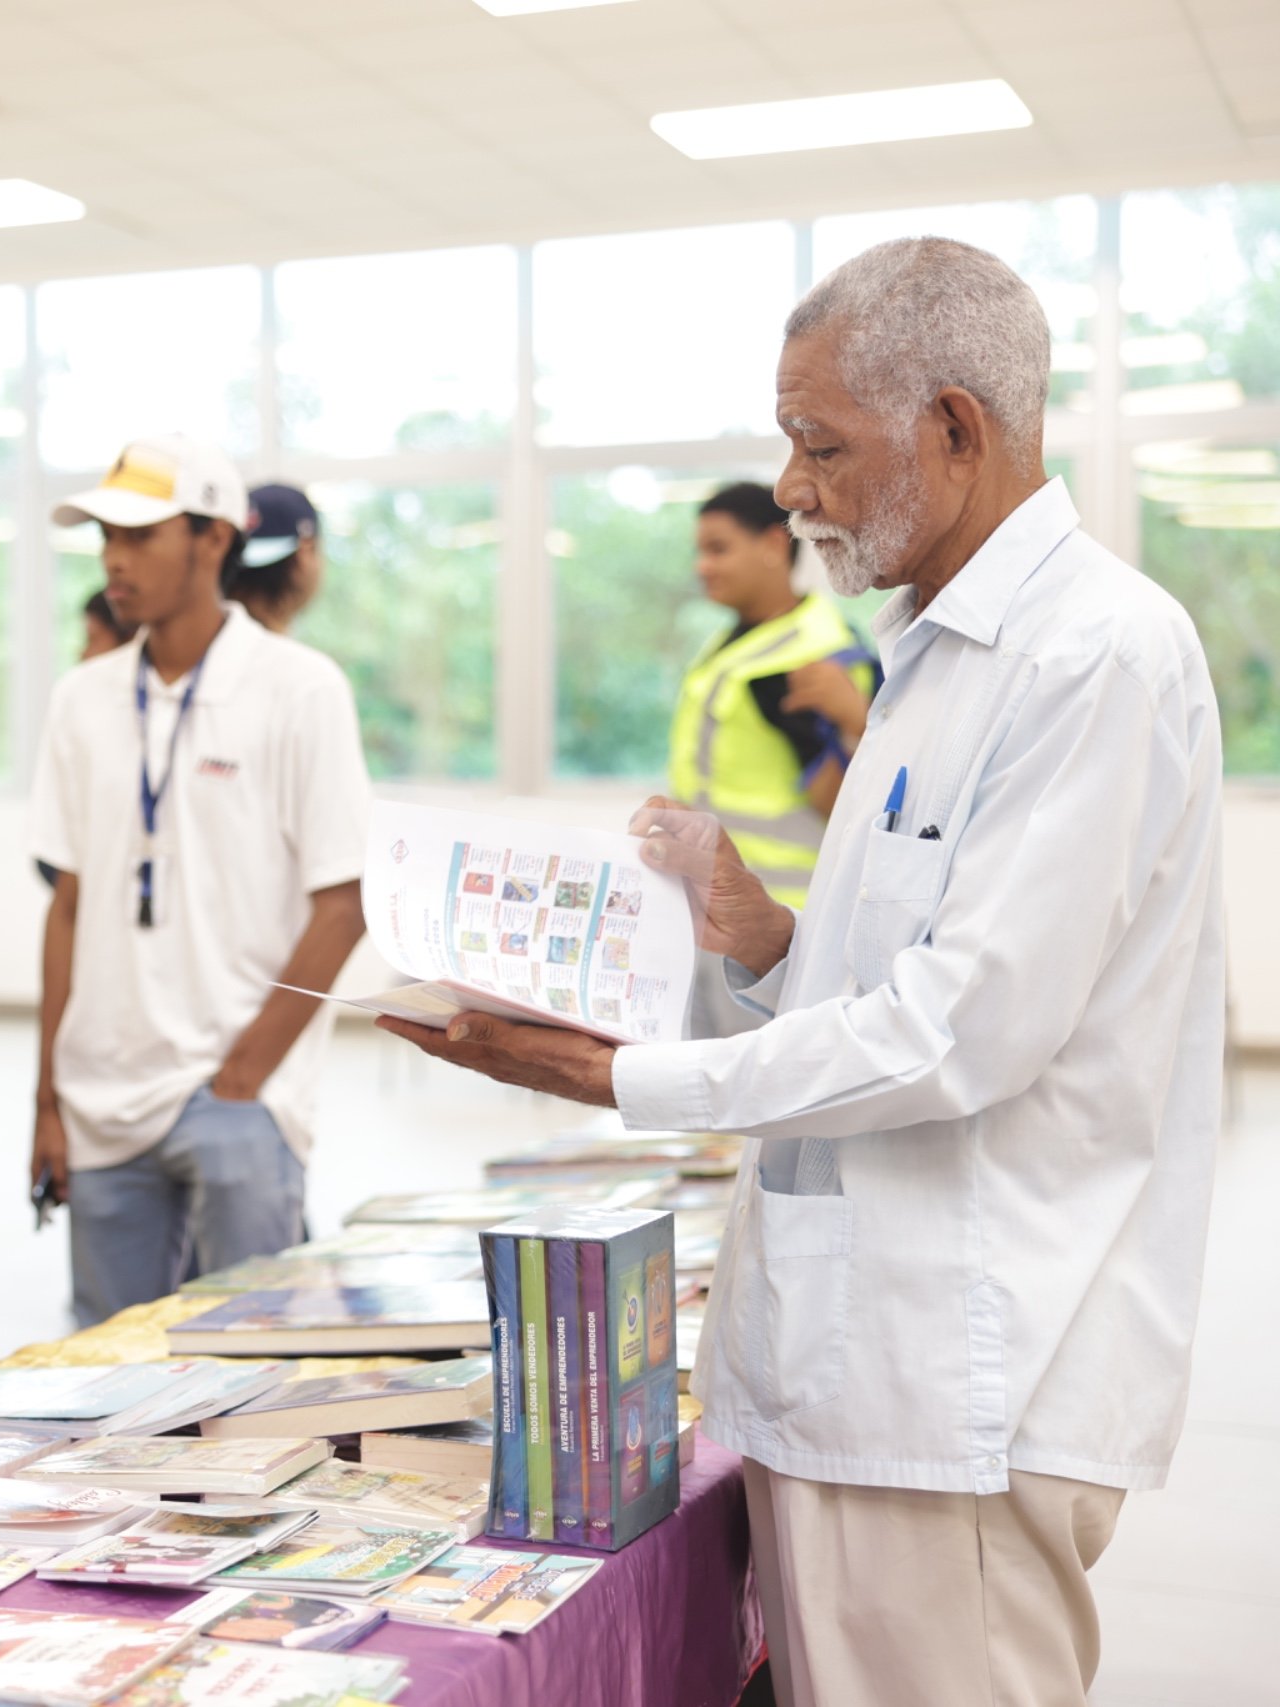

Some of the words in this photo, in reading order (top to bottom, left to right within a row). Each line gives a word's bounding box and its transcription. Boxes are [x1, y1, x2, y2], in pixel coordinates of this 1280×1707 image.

[499, 1316, 509, 1385] EMPRENDEDORES
[527, 1322, 536, 1380] VENDEDORES
[556, 1316, 567, 1391] EMPRENDEDORES
[588, 1311, 596, 1370] EMPRENDEDOR
[501, 1386, 510, 1397] DE
[589, 1371, 597, 1387] DEL
[529, 1382, 537, 1413] SOMOS
[559, 1394, 567, 1405] DE
[590, 1388, 598, 1414] VENTA
[502, 1397, 511, 1433] ESCUELA
[530, 1415, 538, 1444] TODOS
[560, 1407, 569, 1453] AVENTURA
[591, 1415, 599, 1450] PRIMERA
[592, 1451, 600, 1462] LA
